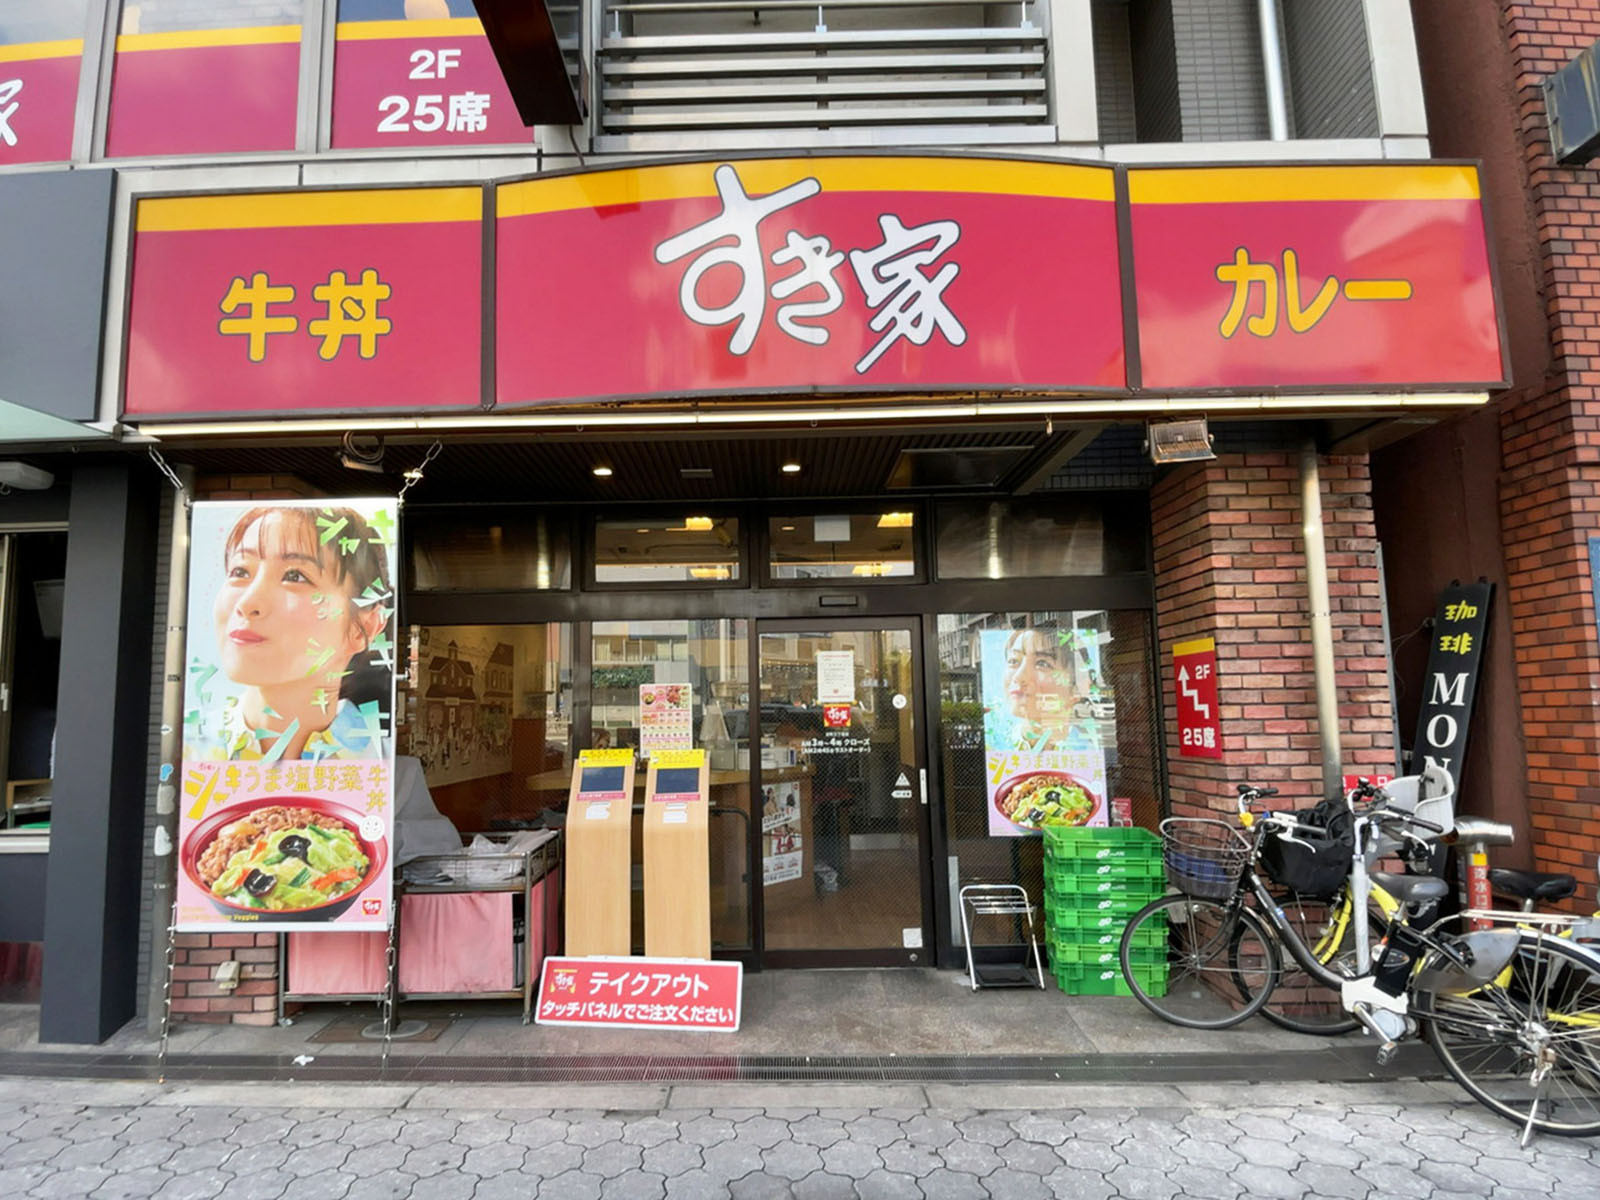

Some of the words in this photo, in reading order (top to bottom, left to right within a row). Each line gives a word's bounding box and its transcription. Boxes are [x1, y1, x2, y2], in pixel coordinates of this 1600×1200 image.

[409, 48, 462, 80] 2F
[376, 92, 491, 133] 25席
[655, 163, 968, 374] すき家
[1215, 247, 1413, 339] カレー
[218, 268, 393, 363] 牛丼
[1439, 599, 1478, 656] 珈琲
[1195, 664, 1211, 680] 2F
[1183, 727, 1215, 748] 25席
[588, 971, 709, 999] テイクアウト
[541, 999, 734, 1024] タッチパネルでご注文ください
